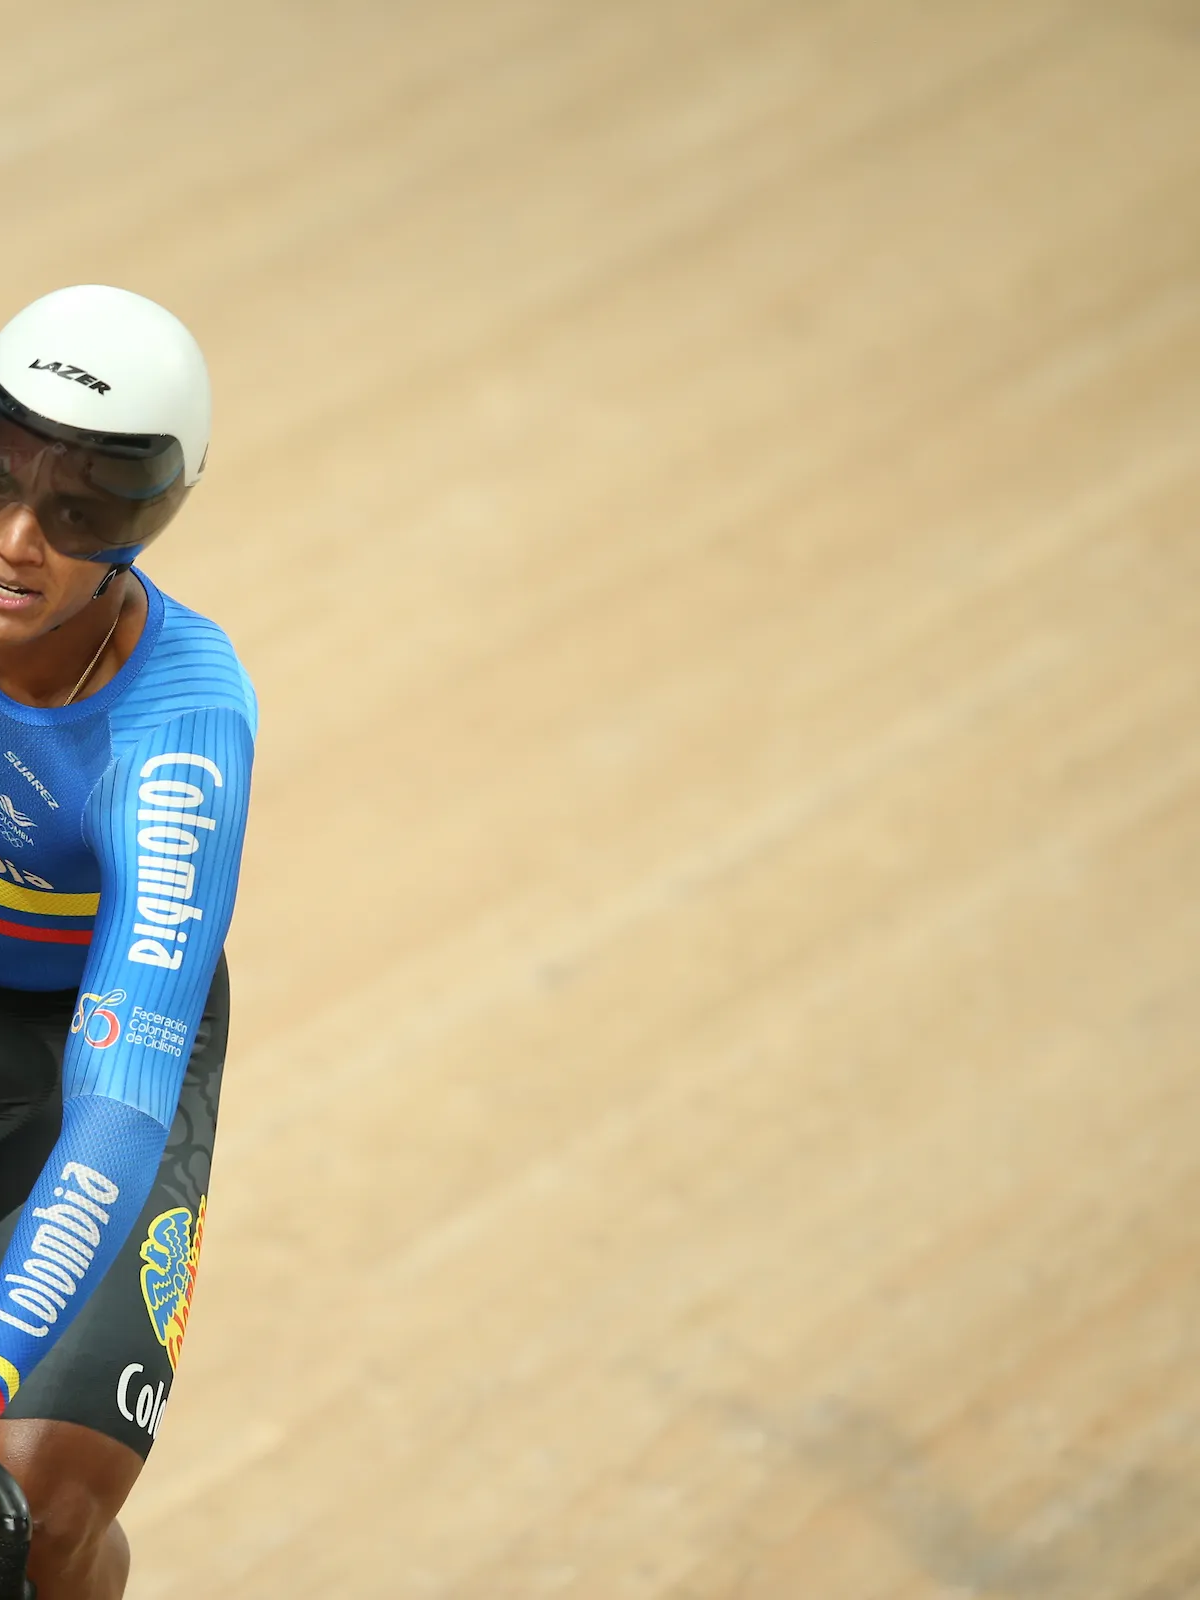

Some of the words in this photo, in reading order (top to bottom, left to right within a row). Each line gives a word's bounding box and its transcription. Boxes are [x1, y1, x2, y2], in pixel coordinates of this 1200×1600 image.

[27, 359, 111, 396] LAZER
[3, 750, 60, 810] SUAREZ
[128, 752, 223, 971] Colombia
[126, 1031, 143, 1045] de
[129, 1019, 185, 1046] Colombana
